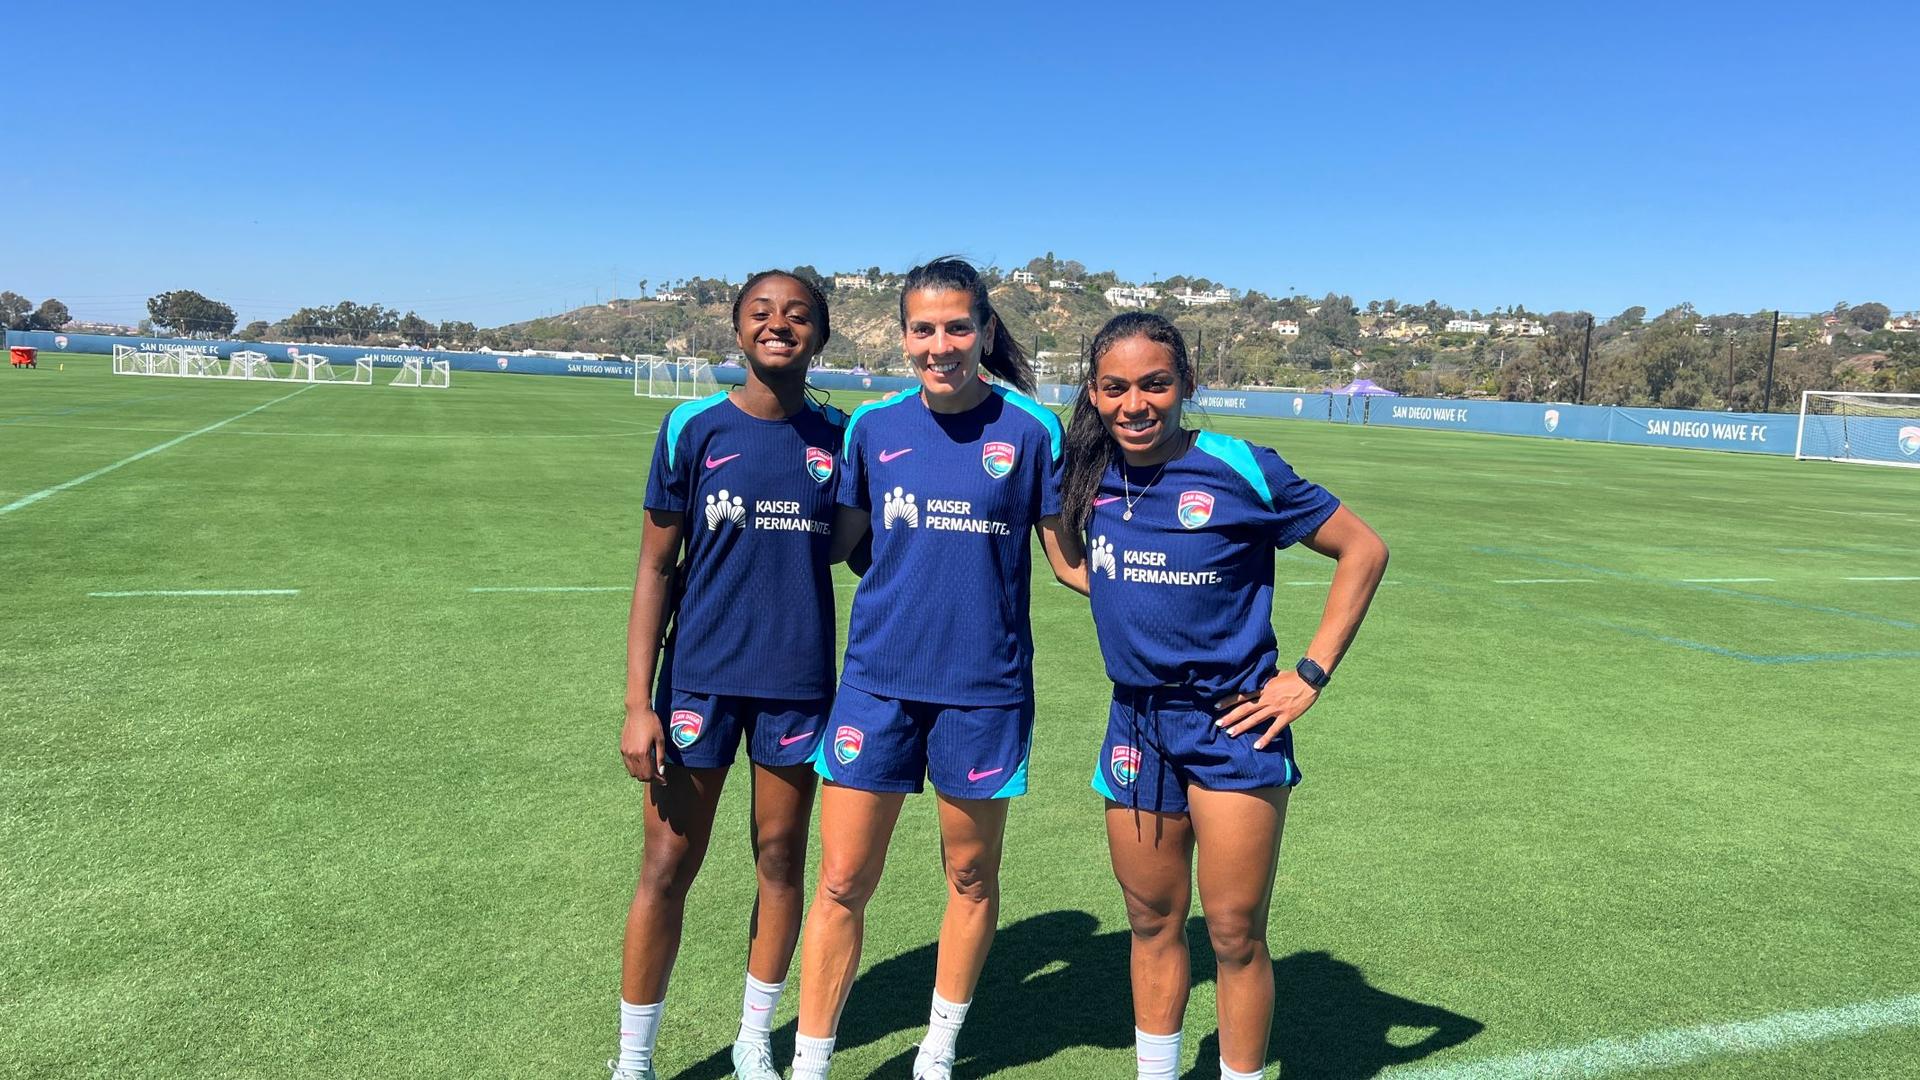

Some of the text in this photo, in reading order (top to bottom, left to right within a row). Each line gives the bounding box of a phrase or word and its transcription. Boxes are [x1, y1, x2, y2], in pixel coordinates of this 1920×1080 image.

[140, 343, 157, 351] SAN
[159, 343, 183, 352] DIEGO
[209, 345, 219, 354] FC
[381, 354, 403, 363] DIEGO
[567, 364, 633, 375] SAN DIEGO WAVE FC
[1208, 397, 1224, 408] DIEGO
[1239, 398, 1246, 408] FC
[1392, 405, 1468, 422] SAN DIEGO WAVE FC
[1646, 419, 1768, 442] SAN DIEGO WAVE FC
[755, 500, 800, 514] KAISER
[926, 499, 971, 515] KAISER
[755, 517, 830, 535] PERMANENTE
[925, 516, 1008, 535] PERMANENTE
[1123, 550, 1167, 567] KAISER
